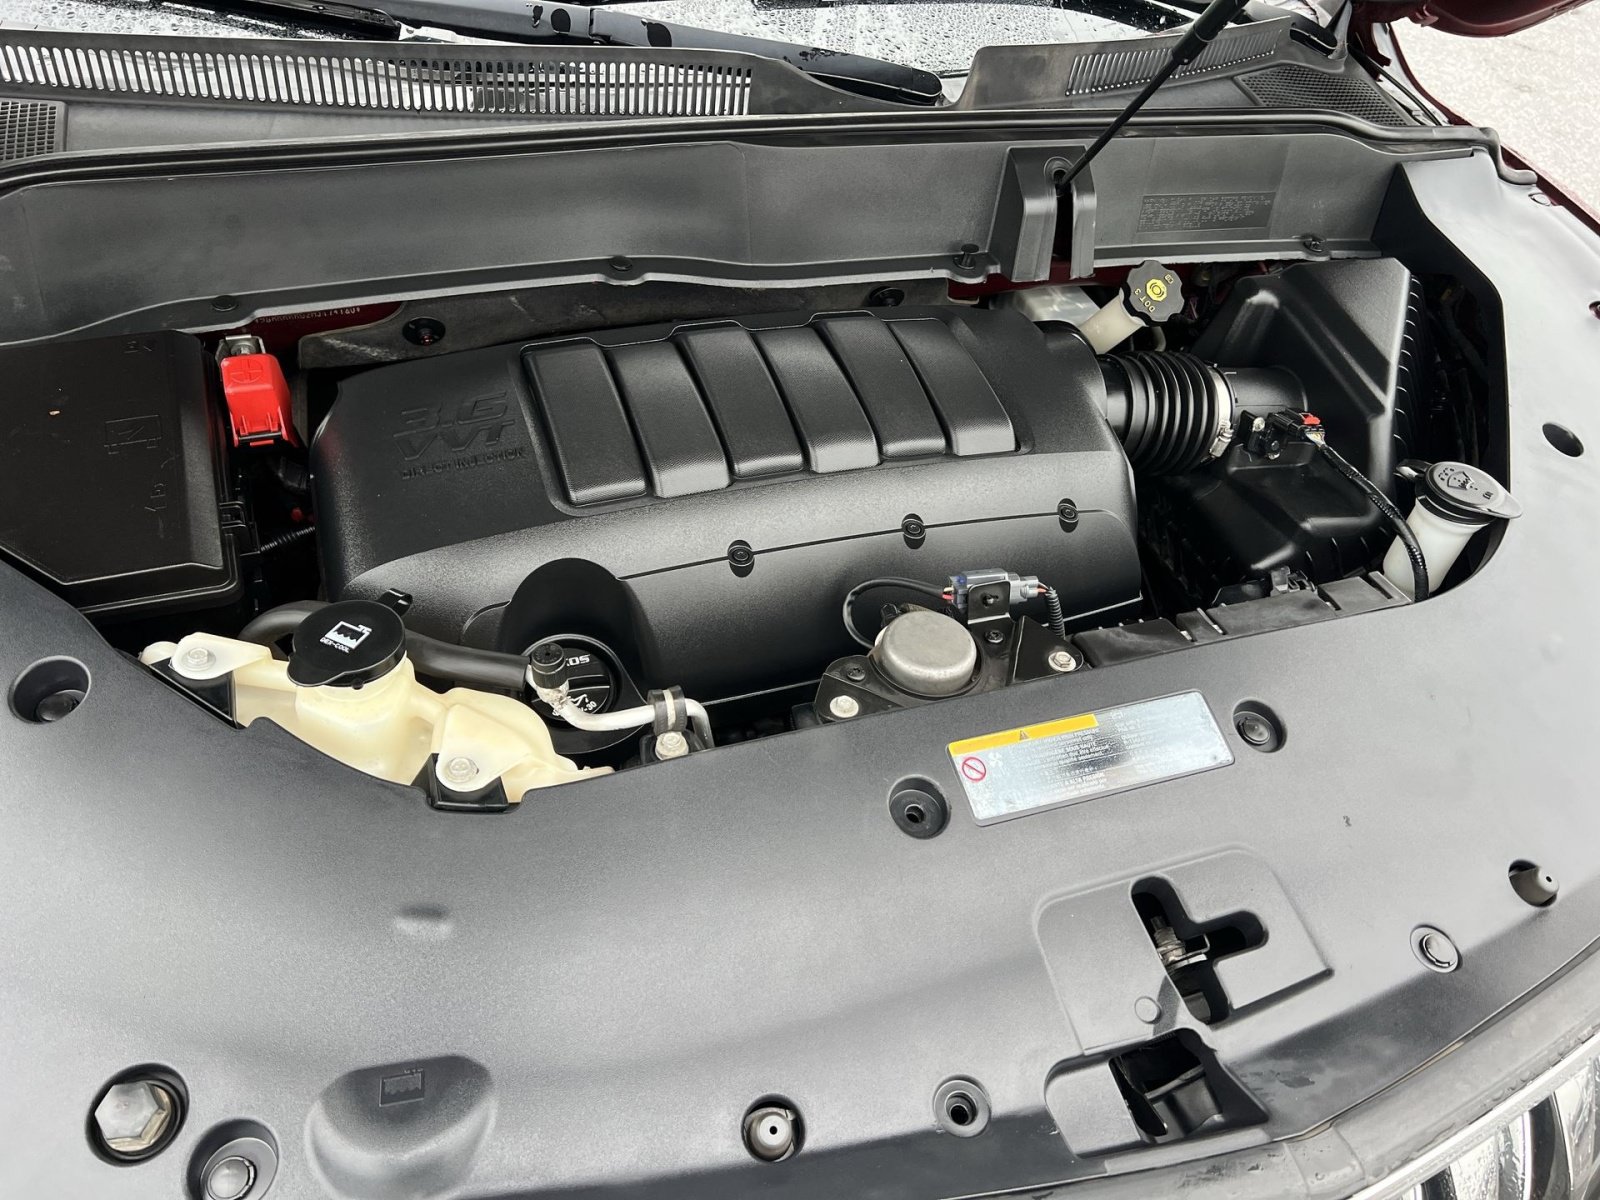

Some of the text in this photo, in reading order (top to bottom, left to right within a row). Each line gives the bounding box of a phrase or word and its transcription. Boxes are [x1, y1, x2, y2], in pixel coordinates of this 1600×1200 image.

[1139, 296, 1155, 313] DOT
[393, 391, 507, 438] 3.6
[394, 419, 515, 461] VVT
[402, 446, 525, 480] DIRECT INJECTION
